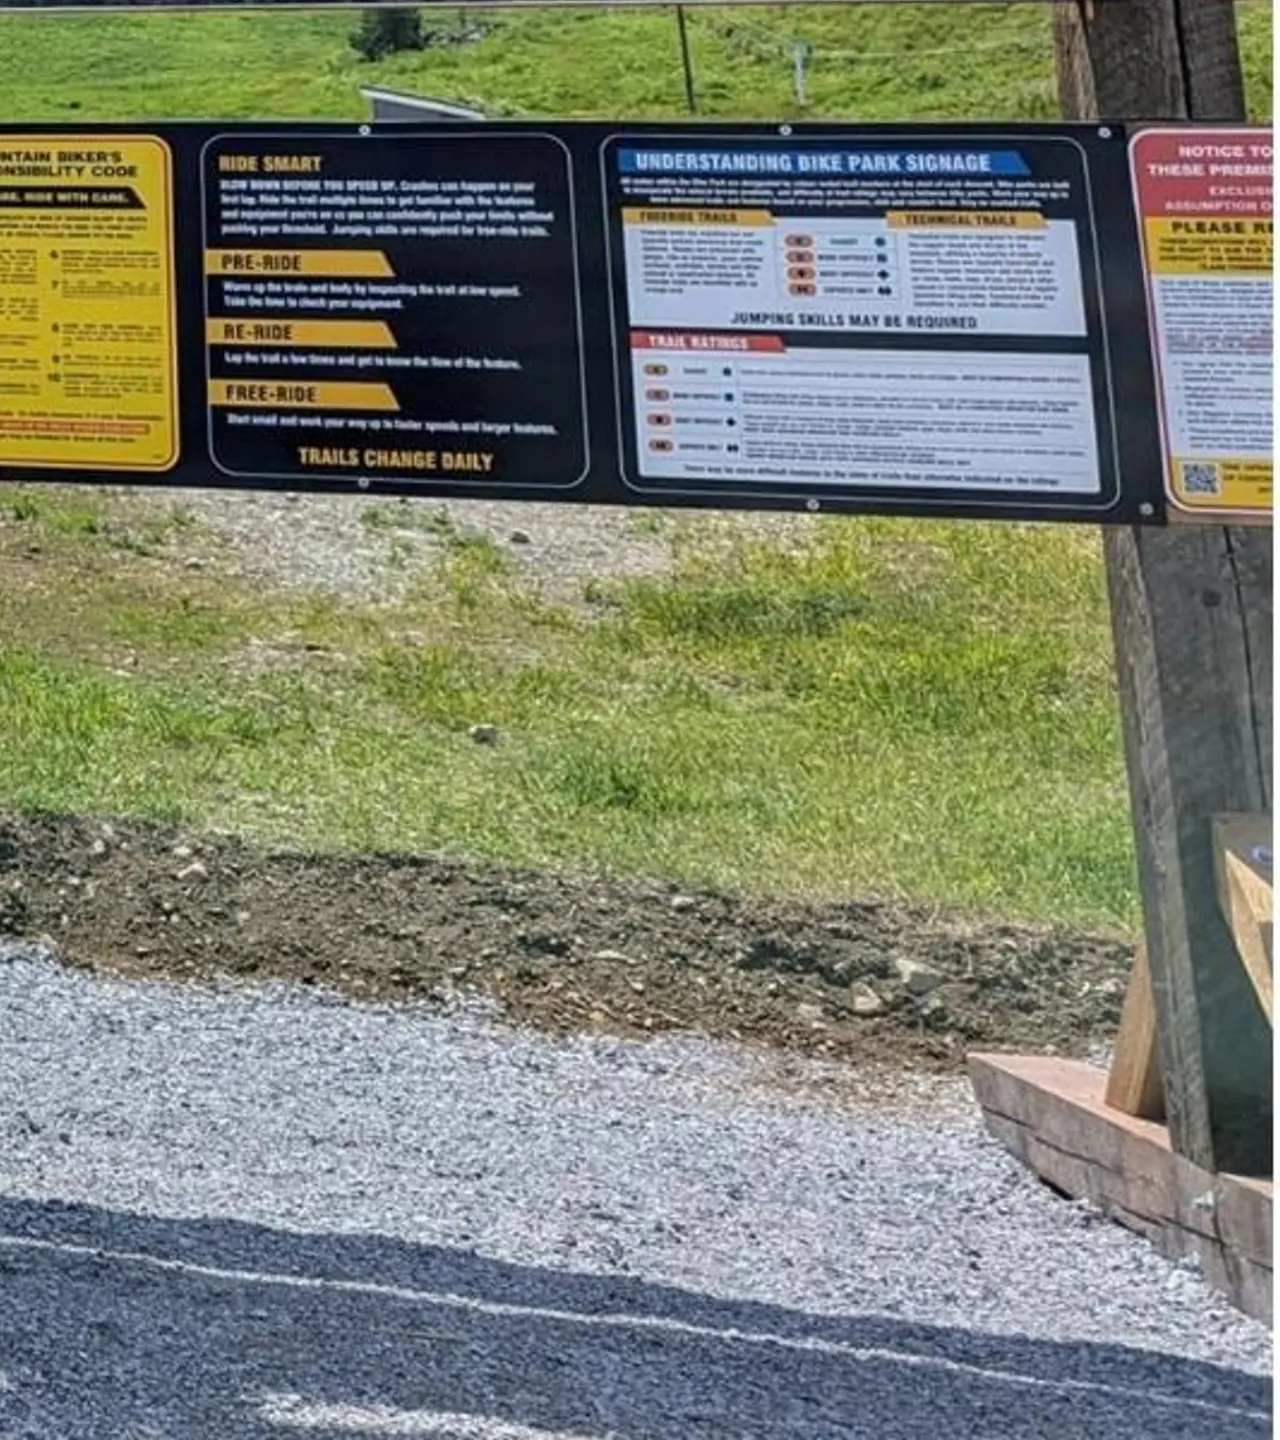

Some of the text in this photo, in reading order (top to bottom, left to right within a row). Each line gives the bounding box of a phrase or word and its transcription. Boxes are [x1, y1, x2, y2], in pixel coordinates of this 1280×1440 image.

[57, 151, 123, 162] BIKER'S
[1179, 145, 1273, 158] NOTICE TO
[219, 155, 322, 172] RIDE SMART
[636, 153, 992, 173] UNDERSTANDING BIKE PARK SIGNAGE
[1147, 163, 1205, 176] THESE
[91, 166, 138, 177] CODE
[24, 192, 53, 202] RIDE
[56, 192, 89, 202] WITH
[1165, 201, 1258, 212] ASSUMPTION
[697, 213, 738, 223] TRAILS
[906, 215, 1017, 226] TECHNICAL TRAILS
[1171, 221, 1246, 234] PLEASE
[221, 253, 302, 272] PRE-RIDE
[731, 312, 978, 329] JUMPING SKILLS MAY BE REQUIRED
[224, 323, 293, 341] RE-RIDE
[648, 335, 749, 349] TRAIL RATINGS
[226, 384, 317, 403] FREE-RIDE
[297, 446, 495, 472] TRAILS CHANGE DAILY
